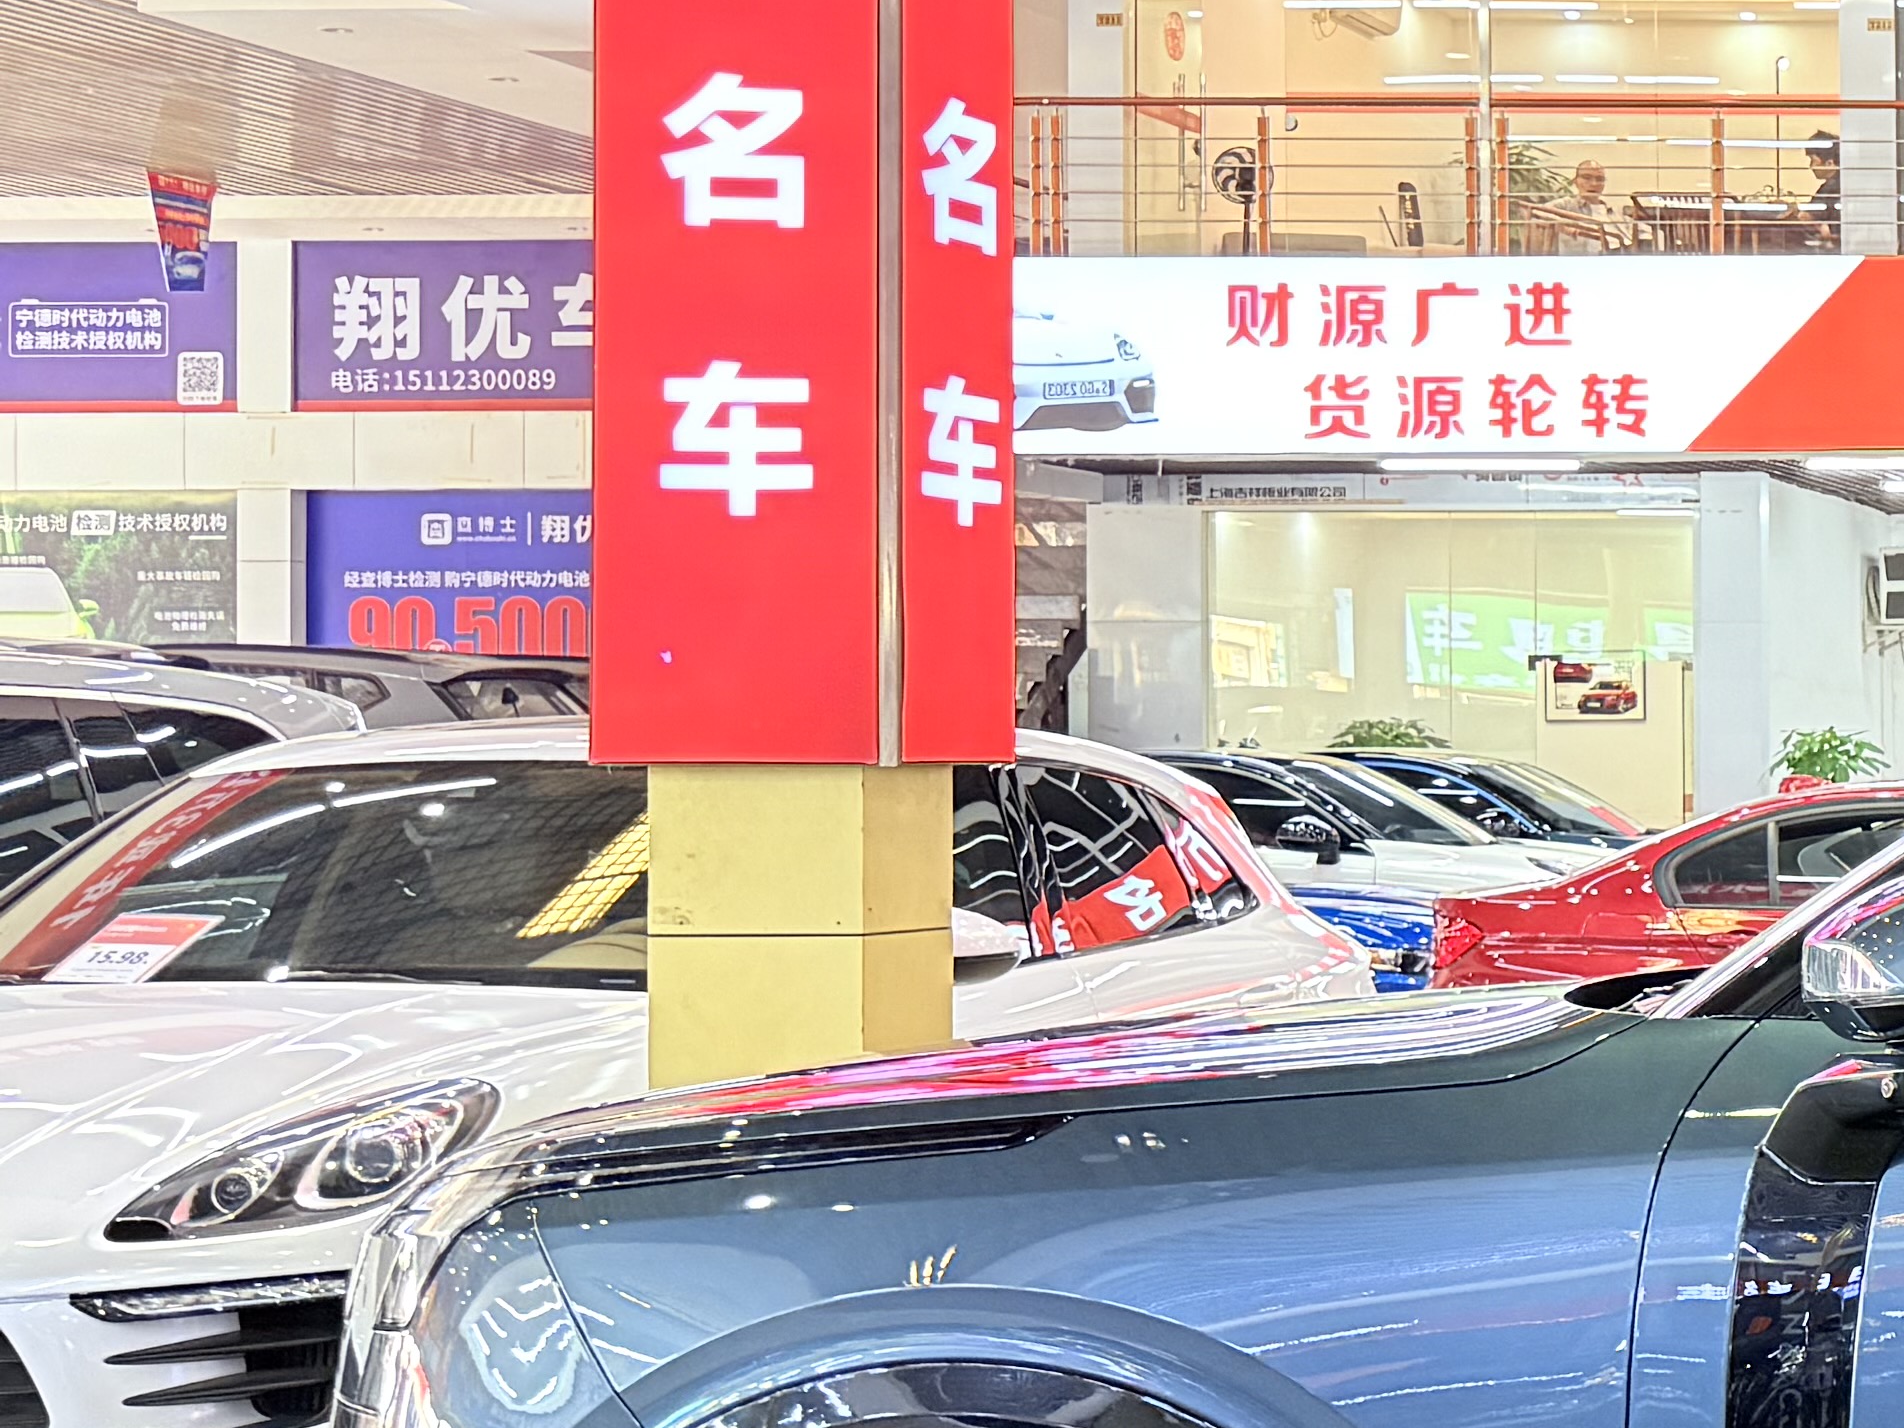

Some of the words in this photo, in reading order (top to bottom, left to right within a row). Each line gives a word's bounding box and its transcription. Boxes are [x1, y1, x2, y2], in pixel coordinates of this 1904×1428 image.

[15, 308, 162, 328] 宁德时代动力电池
[1226, 281, 1574, 348] 财源广进
[15, 331, 162, 350] 检测技术授权机构
[1304, 373, 1650, 440] 货源轮转
[118, 513, 228, 532] 技术授权机构
